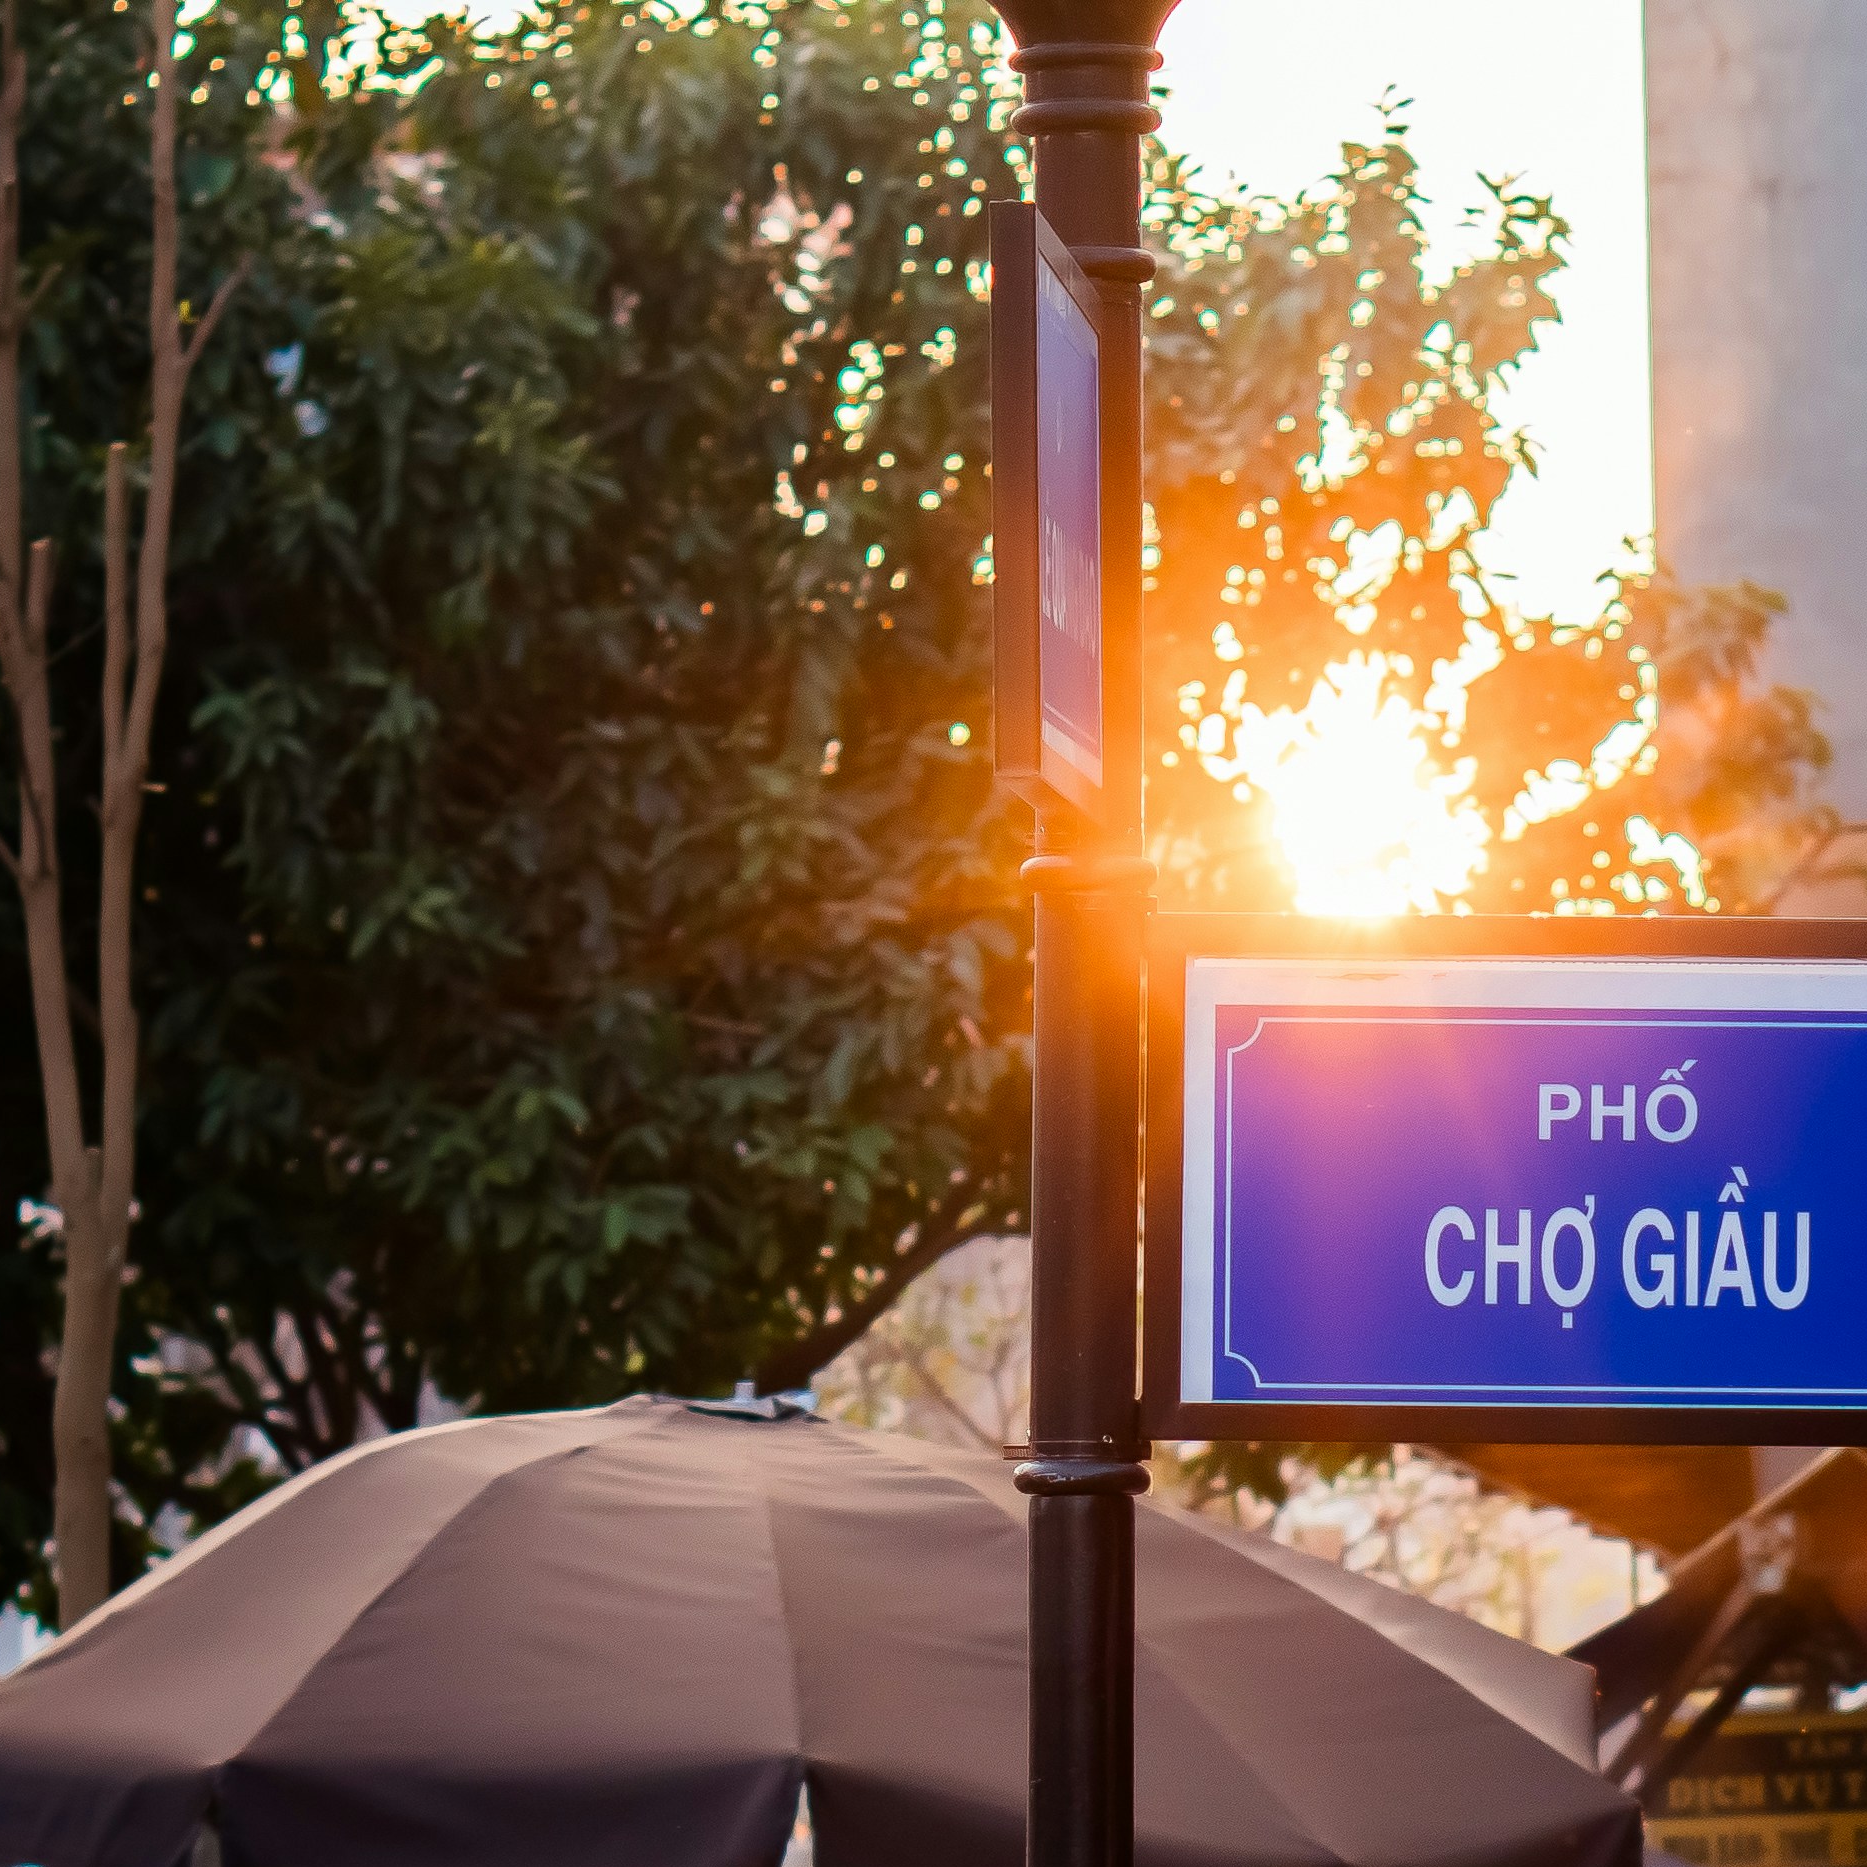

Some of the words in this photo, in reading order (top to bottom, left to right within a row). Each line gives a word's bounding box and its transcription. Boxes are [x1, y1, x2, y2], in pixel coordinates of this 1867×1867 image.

[1537, 1058, 1699, 1144] PHỐ
[1423, 1193, 1598, 1330] CHỢ
[1620, 1164, 1811, 1311] GIẦU
